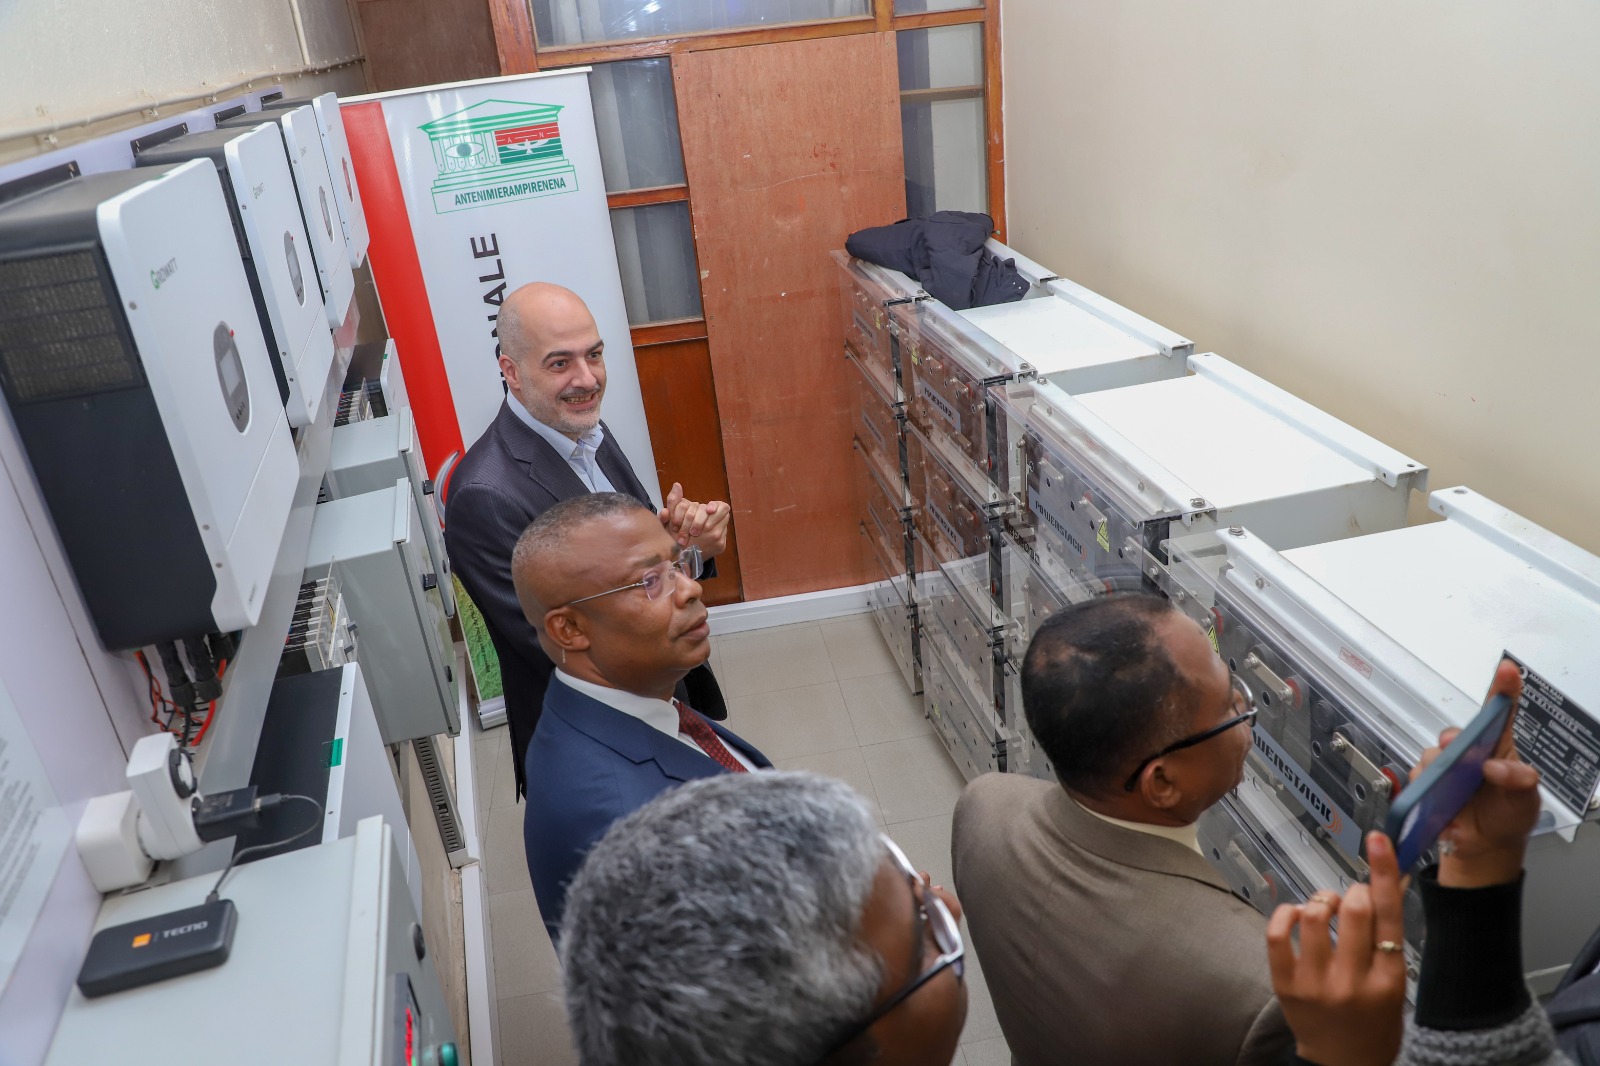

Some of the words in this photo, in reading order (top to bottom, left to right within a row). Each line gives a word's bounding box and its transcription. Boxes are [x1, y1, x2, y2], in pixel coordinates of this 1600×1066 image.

[454, 177, 566, 206] ANTENIMIERAMPIRENENA
[1035, 501, 1083, 554] POWERSTACK
[1252, 730, 1332, 822] WERSTACK
[162, 920, 208, 939] TECNO
